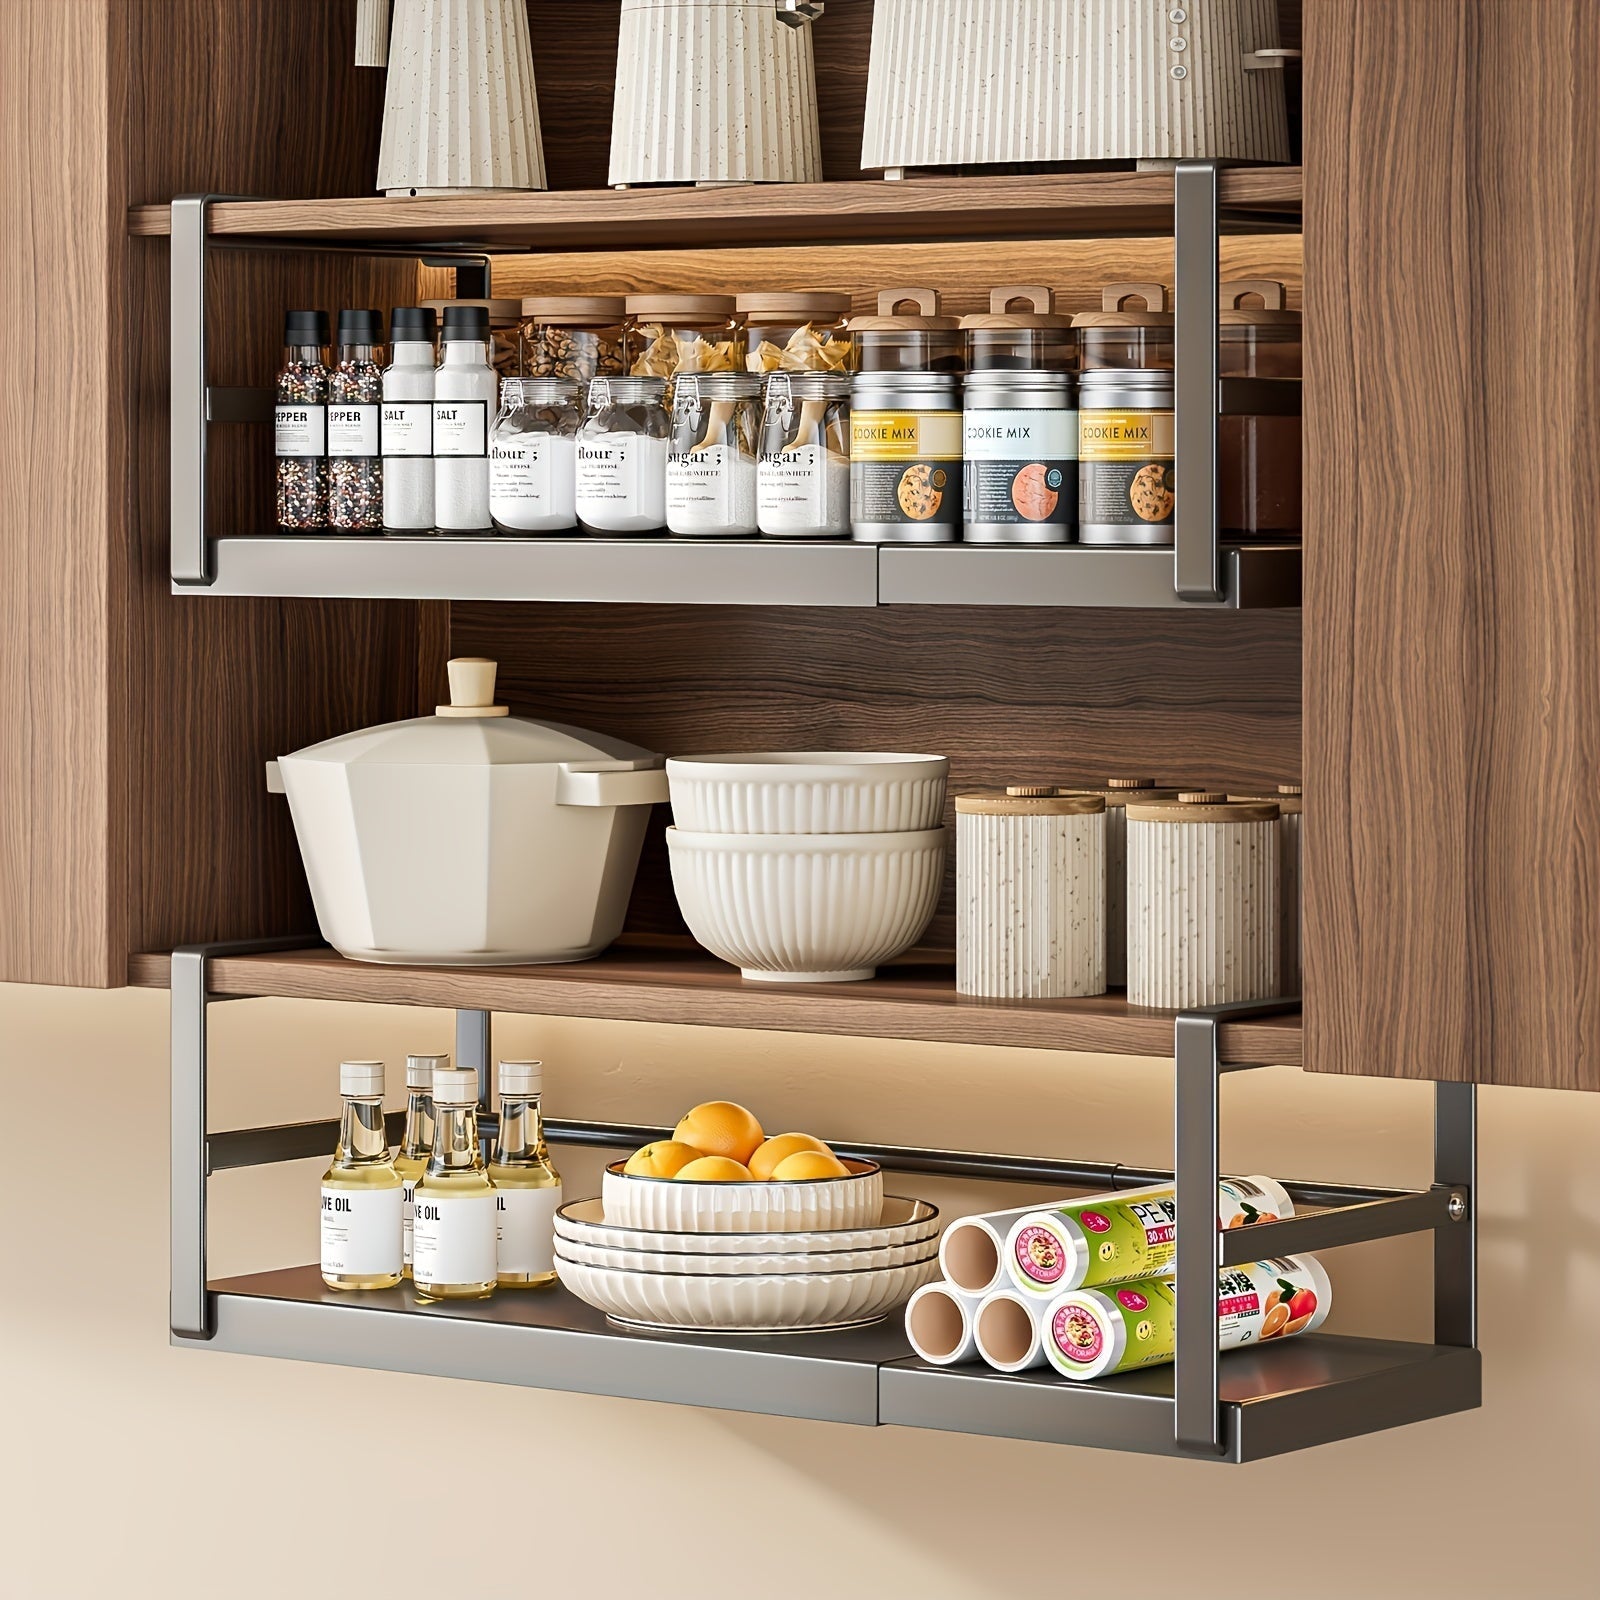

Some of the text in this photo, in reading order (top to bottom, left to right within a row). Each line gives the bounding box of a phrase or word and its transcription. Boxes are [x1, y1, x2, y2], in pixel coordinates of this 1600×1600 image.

[384, 410, 405, 421] SALT
[436, 410, 457, 420] SALT
[854, 428, 915, 439] COOKIE MIX
[967, 427, 1031, 439] COOKIE MIX
[1083, 427, 1149, 439] COOKIE MIX
[491, 446, 526, 460] flour
[578, 446, 613, 460] flour
[667, 452, 709, 468] sugar
[758, 452, 801, 468] sugar
[335, 1197, 352, 1212] OIL
[425, 1205, 441, 1221] OIL
